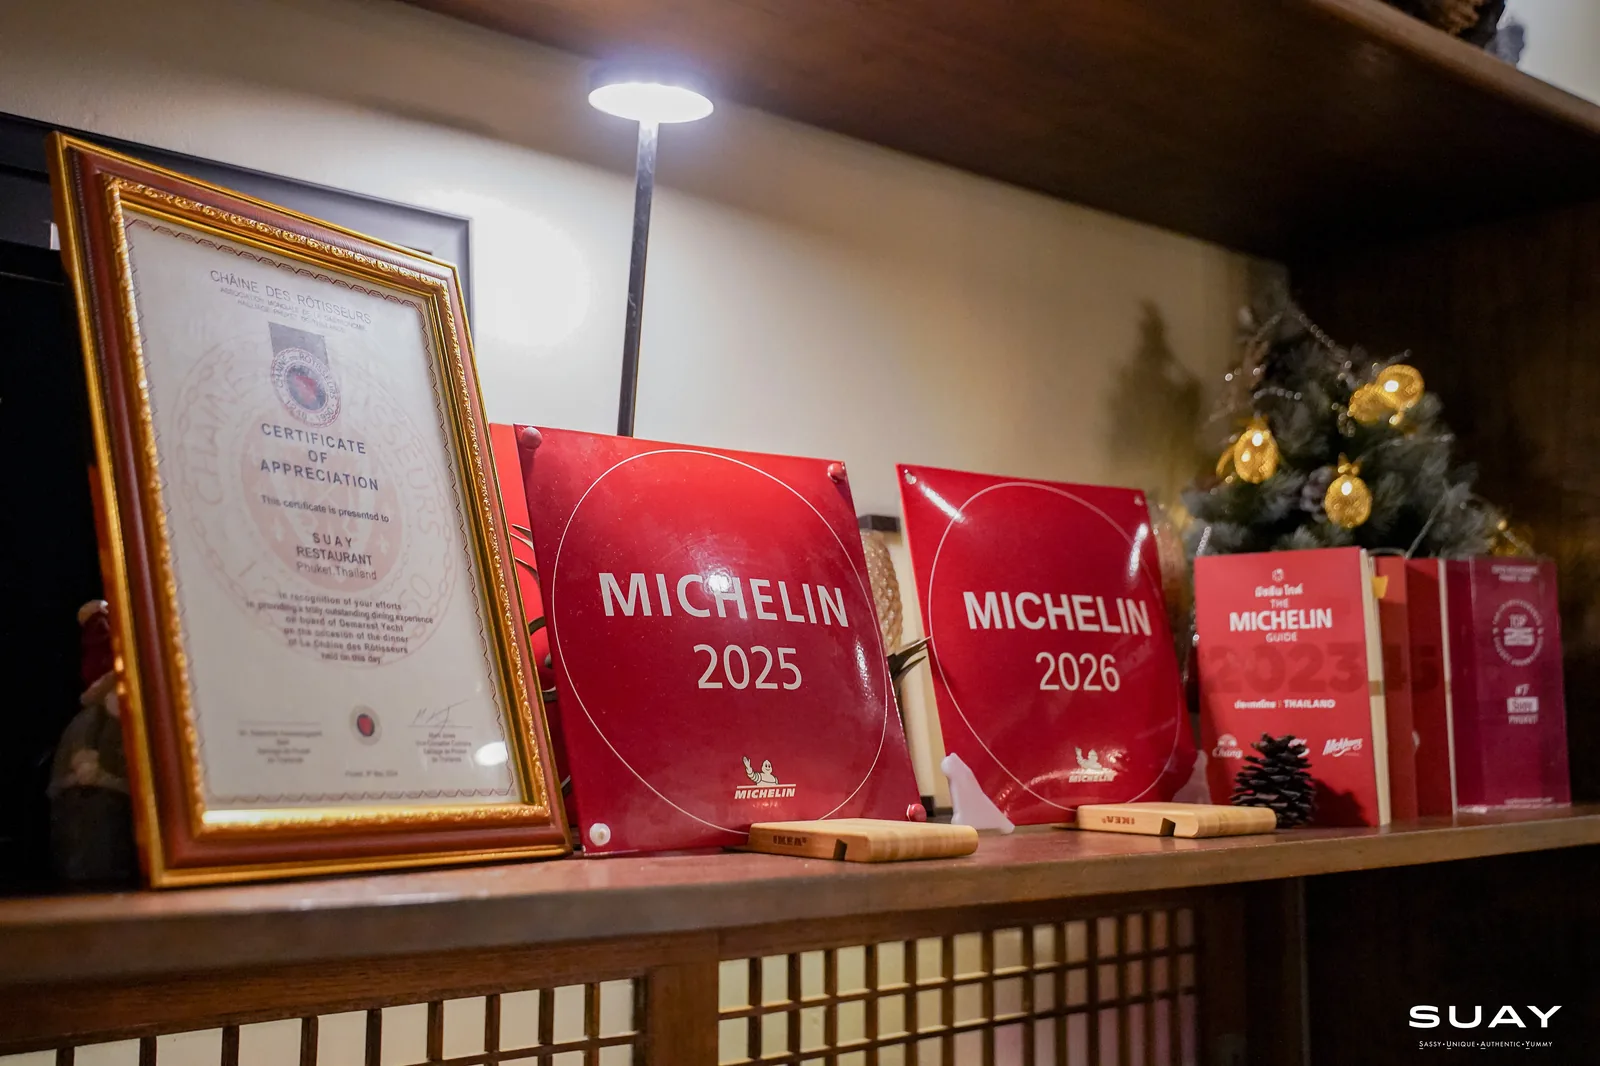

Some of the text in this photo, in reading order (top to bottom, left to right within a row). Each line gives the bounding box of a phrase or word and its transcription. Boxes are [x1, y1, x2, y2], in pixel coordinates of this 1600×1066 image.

[265, 285, 291, 302] DES
[296, 294, 372, 325] RÔTISSEURS
[261, 422, 366, 455] CERTIFICATE
[307, 449, 328, 464] OF
[260, 459, 379, 491] APPRECIATION
[261, 494, 390, 523] This certificate is presented to
[296, 546, 373, 566] RESTAURANT
[290, 593, 340, 605] recognition
[343, 597, 352, 606] of
[354, 599, 373, 609] your
[375, 600, 402, 611] efforts
[598, 572, 850, 628] MICHELIN
[1269, 598, 1290, 609] THE
[325, 607, 370, 621] outstanding
[371, 611, 395, 622] dining
[395, 614, 434, 624] experience
[962, 591, 1152, 636] MICHELIN
[1229, 608, 1333, 632] MICHELIN
[327, 617, 337, 627] of
[381, 621, 404, 632] Yacht
[346, 641, 362, 651] des
[356, 631, 365, 640] of
[367, 632, 381, 642] the
[383, 633, 409, 644] dinner
[1265, 631, 1298, 643] GUIDE
[692, 643, 802, 690] 2025
[1035, 651, 1121, 692] 2026
[1206, 641, 1365, 694] 2023
[1283, 698, 1336, 709] THAILAND
[1068, 773, 1115, 784] MICHELIN
[734, 787, 796, 800] MICHELIN
